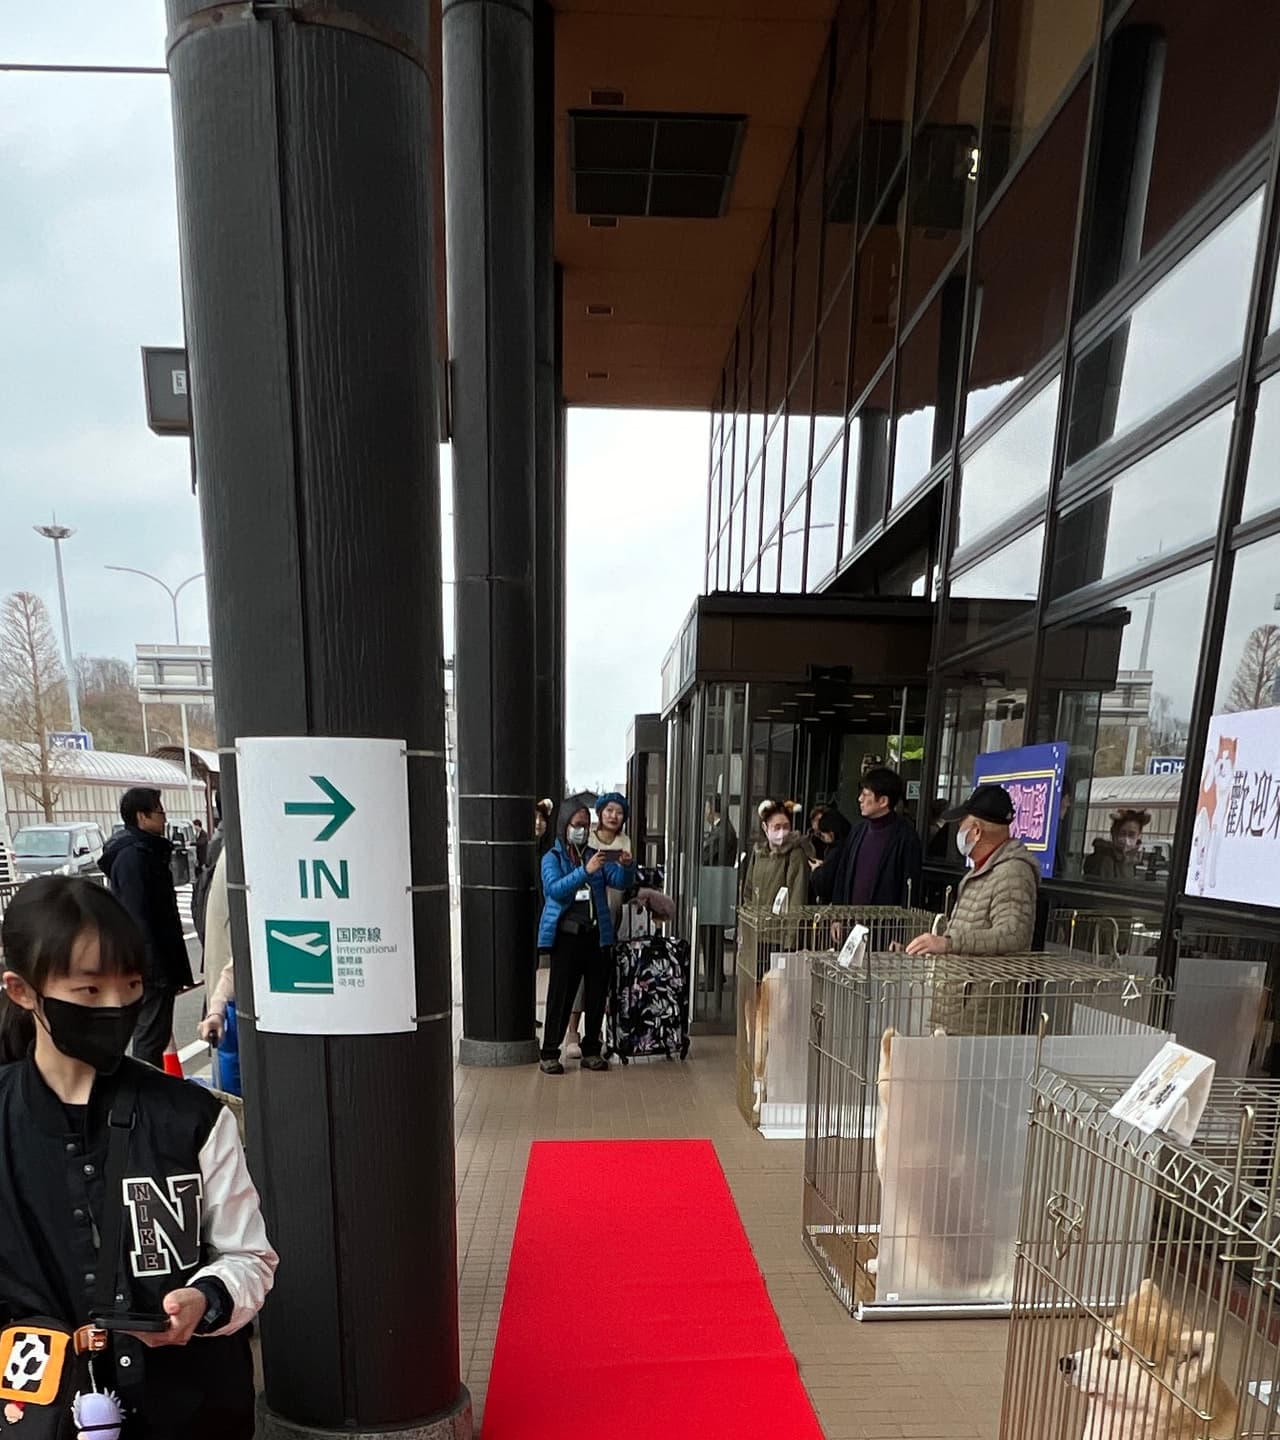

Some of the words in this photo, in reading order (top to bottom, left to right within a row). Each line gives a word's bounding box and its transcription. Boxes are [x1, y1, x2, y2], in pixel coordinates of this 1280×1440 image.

[298, 859, 350, 899] IN
[336, 927, 382, 943] 国際線
[336, 944, 398, 954] International
[134, 1184, 159, 1270] NIKE
